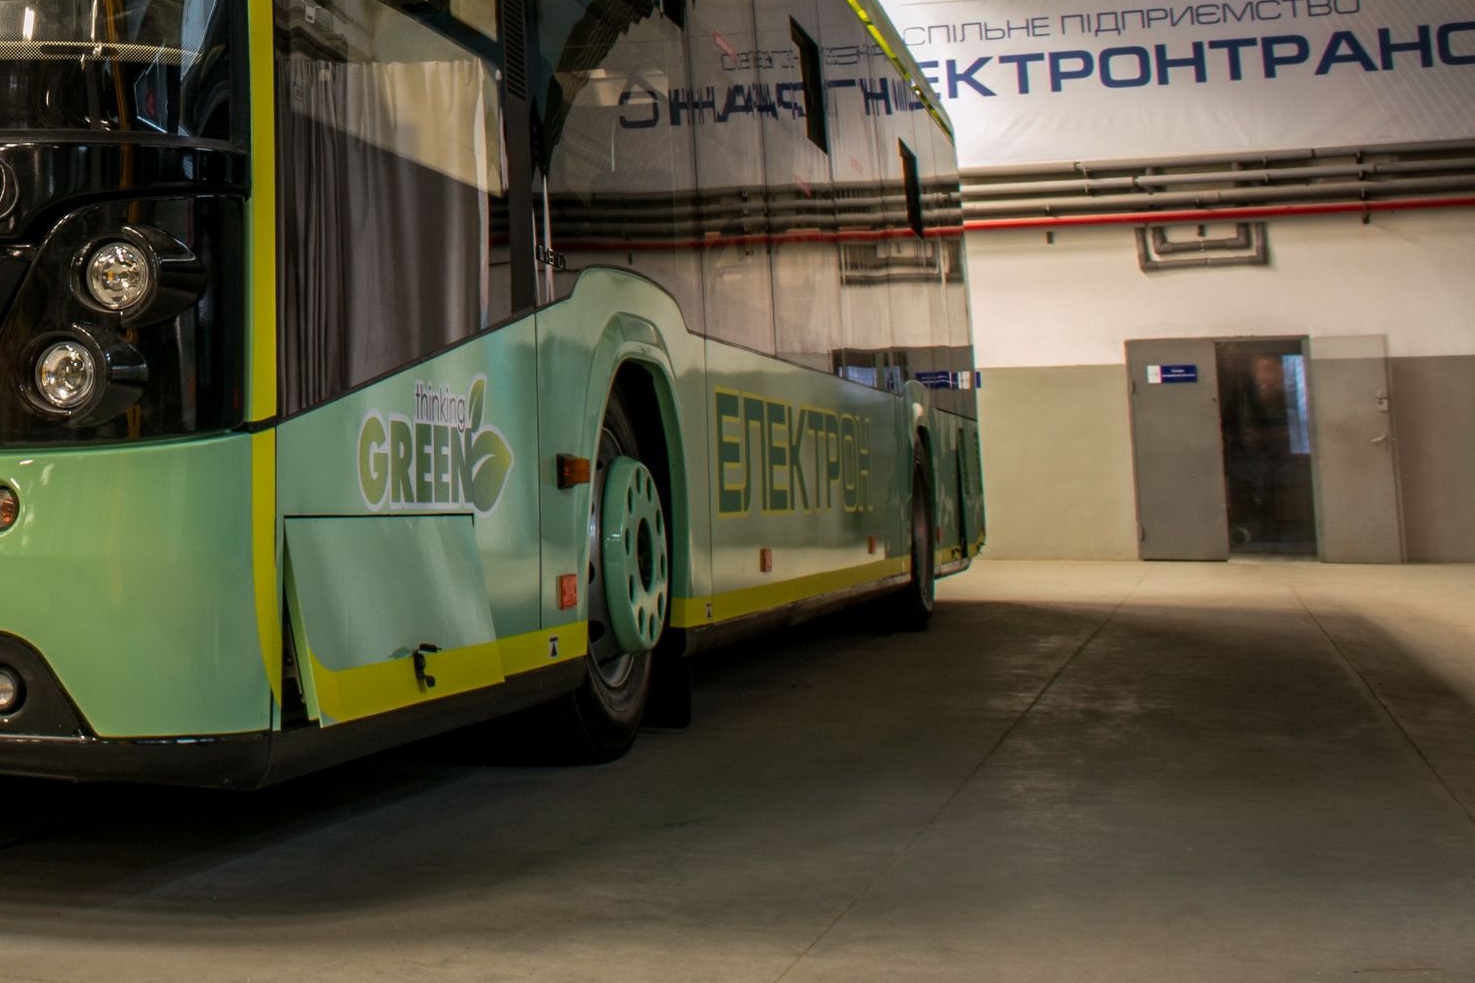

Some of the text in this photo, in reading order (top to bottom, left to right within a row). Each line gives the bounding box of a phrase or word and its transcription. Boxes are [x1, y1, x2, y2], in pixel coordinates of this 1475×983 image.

[903, 17, 1051, 47] СПІЛЬНЕ
[415, 381, 466, 433] thinking
[359, 416, 477, 505] GREEN
